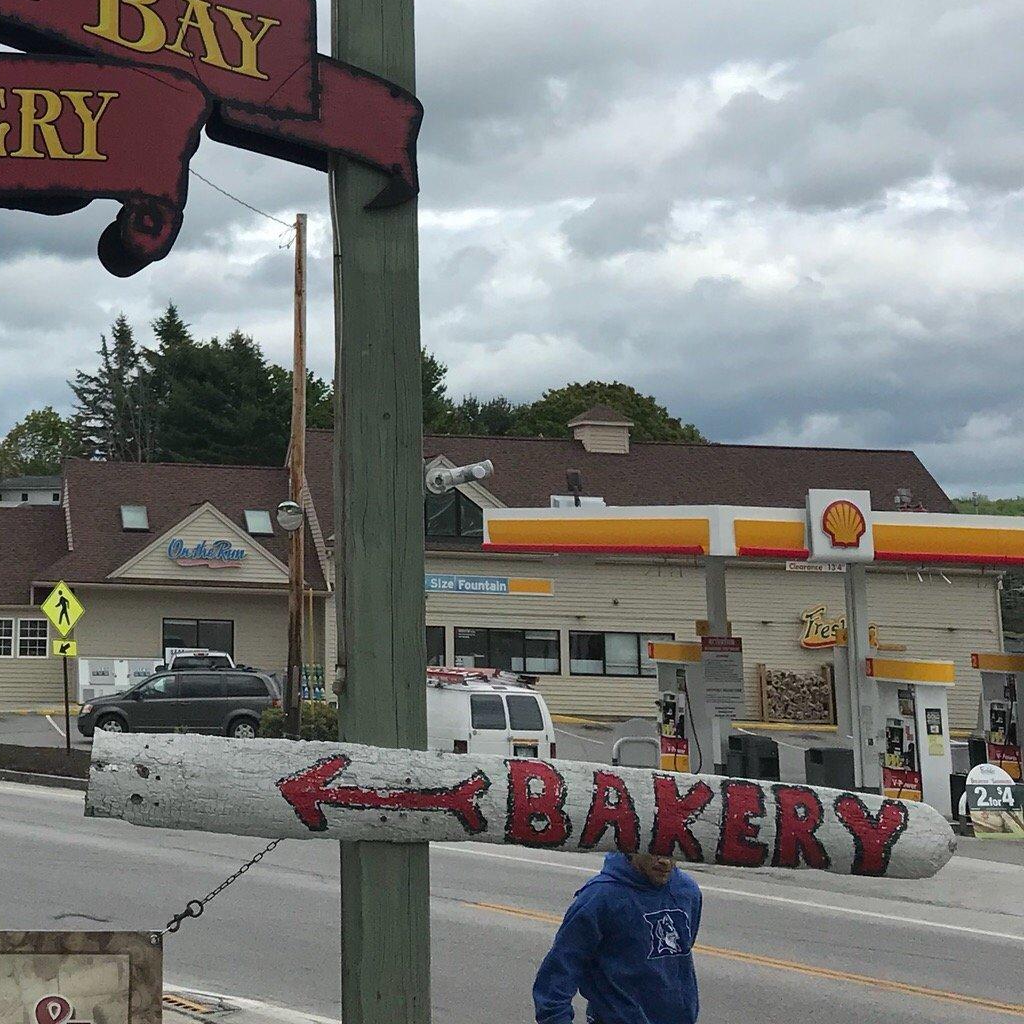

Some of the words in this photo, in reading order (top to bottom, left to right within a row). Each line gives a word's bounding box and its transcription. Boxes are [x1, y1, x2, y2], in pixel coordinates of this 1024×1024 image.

[167, 537, 190, 559] On
[191, 539, 213, 559] the
[213, 539, 248, 561] Run
[789, 562, 823, 571] Clearance
[430, 578, 455, 589] Size
[458, 579, 507, 592] Fountain
[974, 786, 990, 807] 2
[505, 758, 910, 877] BAKERY
